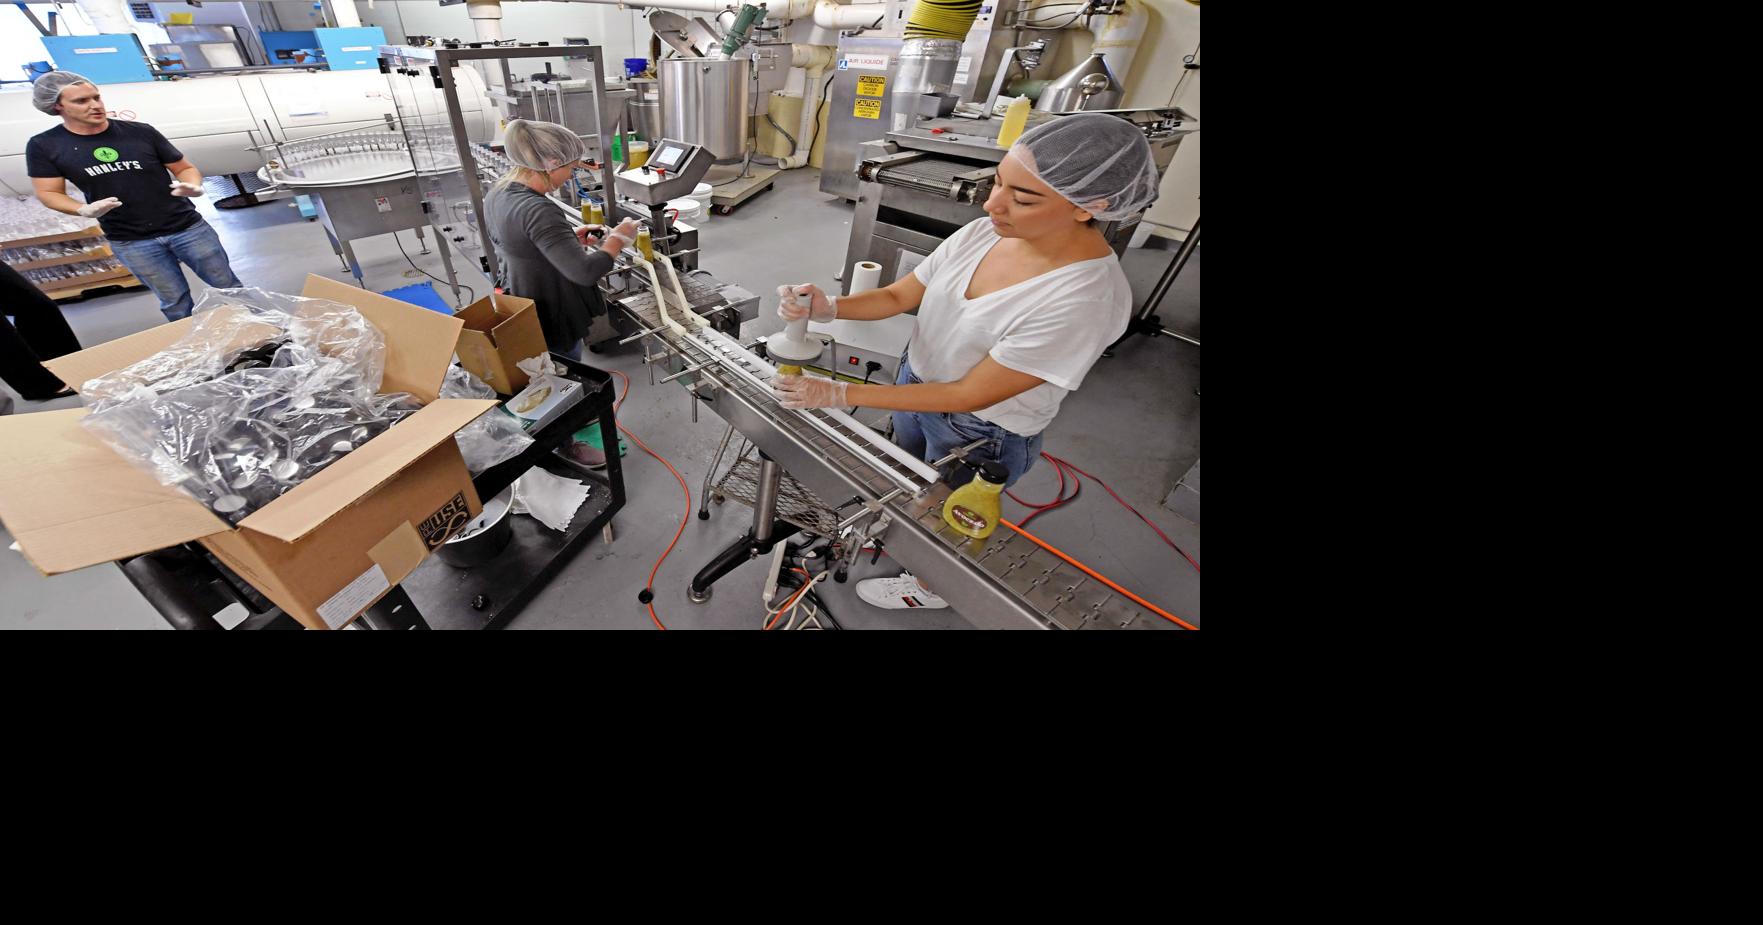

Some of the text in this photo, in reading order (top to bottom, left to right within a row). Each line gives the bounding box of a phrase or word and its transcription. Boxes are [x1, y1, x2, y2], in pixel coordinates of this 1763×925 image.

[858, 76, 885, 84] CAUTION
[855, 100, 881, 108] CAUTION
[84, 160, 143, 177] HANLEY'S
